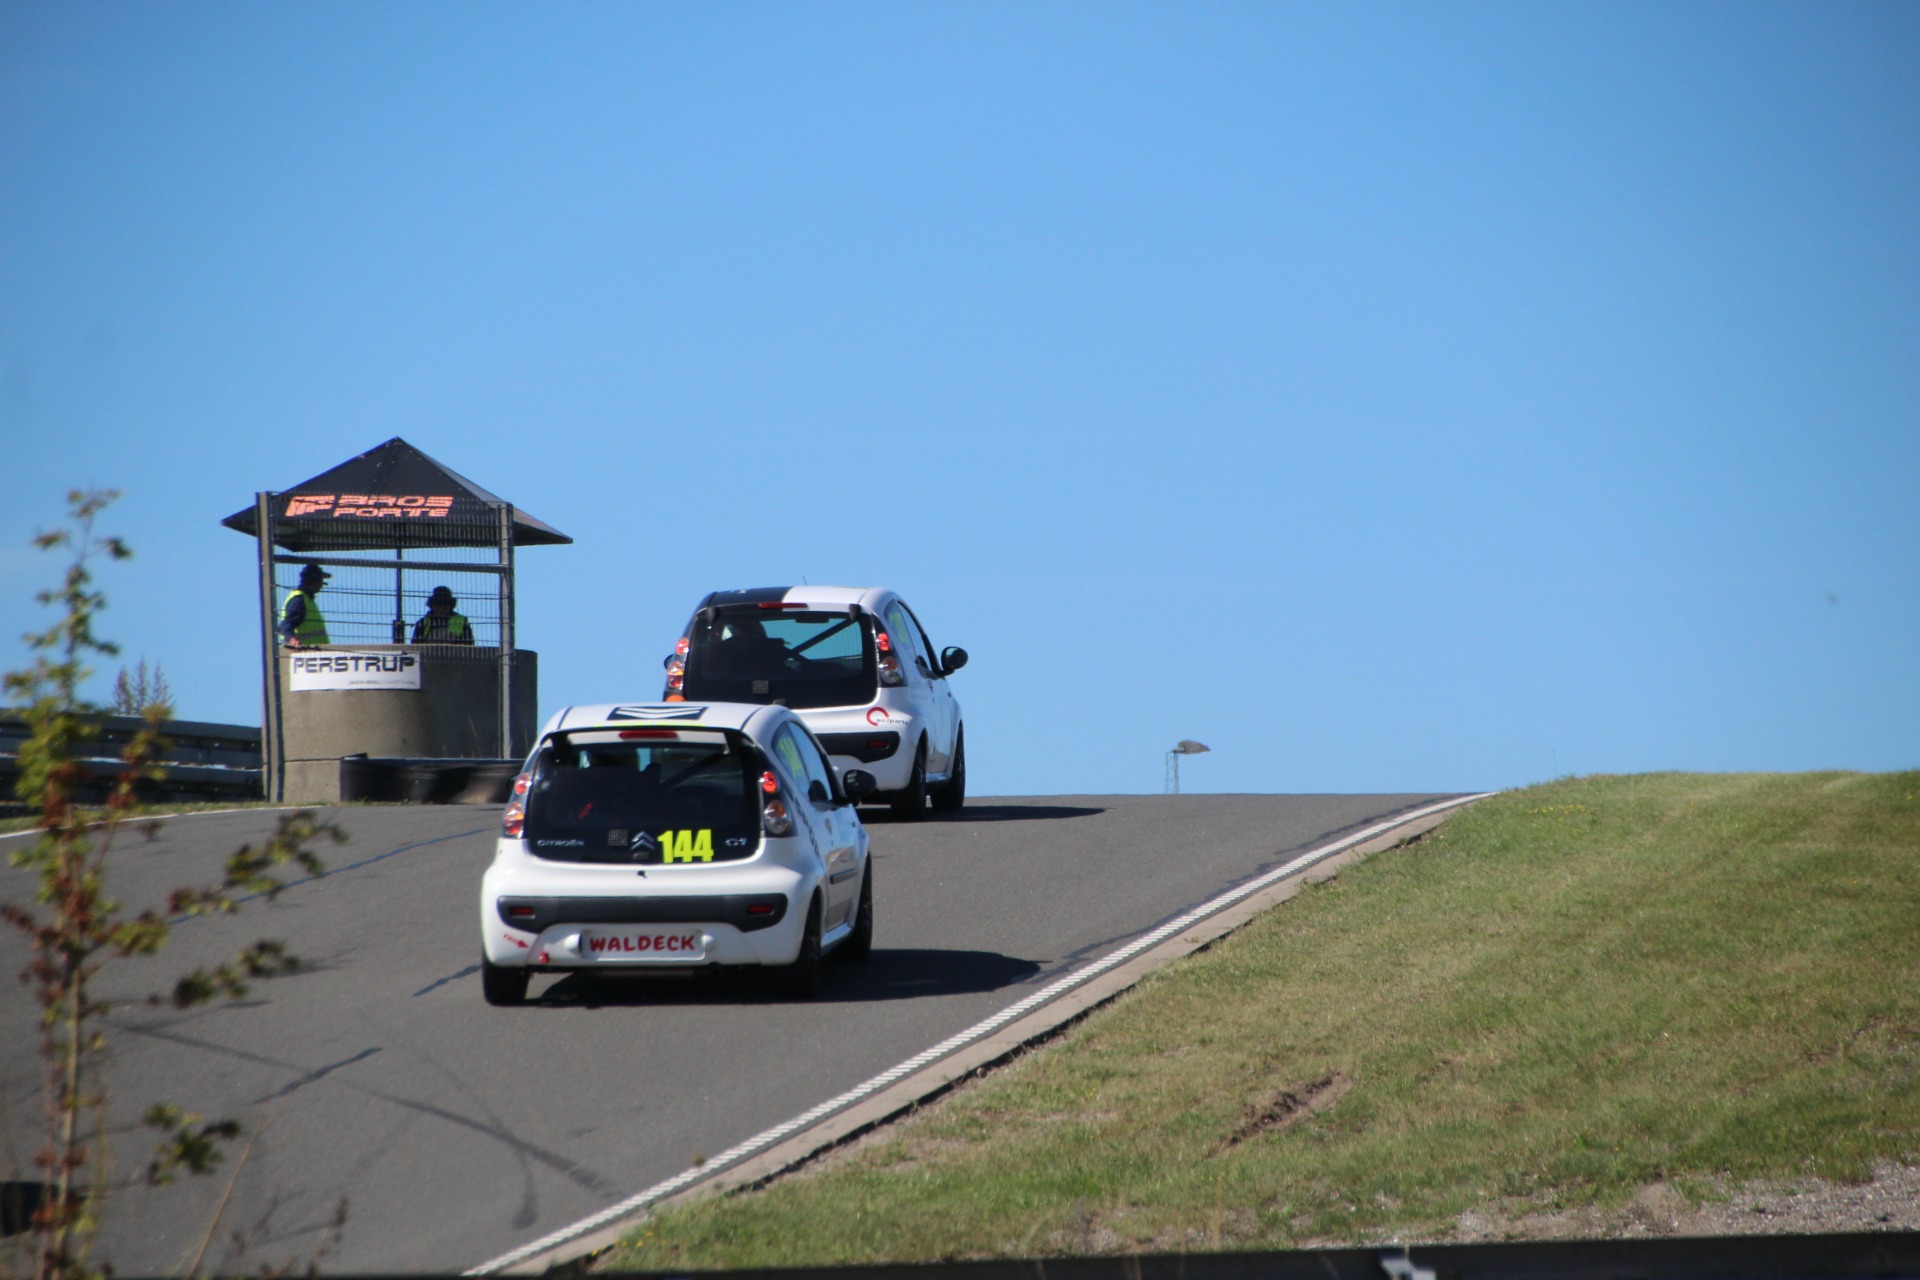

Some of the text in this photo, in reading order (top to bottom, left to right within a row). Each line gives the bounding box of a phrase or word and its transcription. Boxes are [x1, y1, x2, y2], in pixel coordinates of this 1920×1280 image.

[333, 507, 449, 517] PORTE
[294, 656, 415, 673] PERSTRUP
[657, 829, 714, 864] 144
[589, 935, 696, 952] WALDECK
